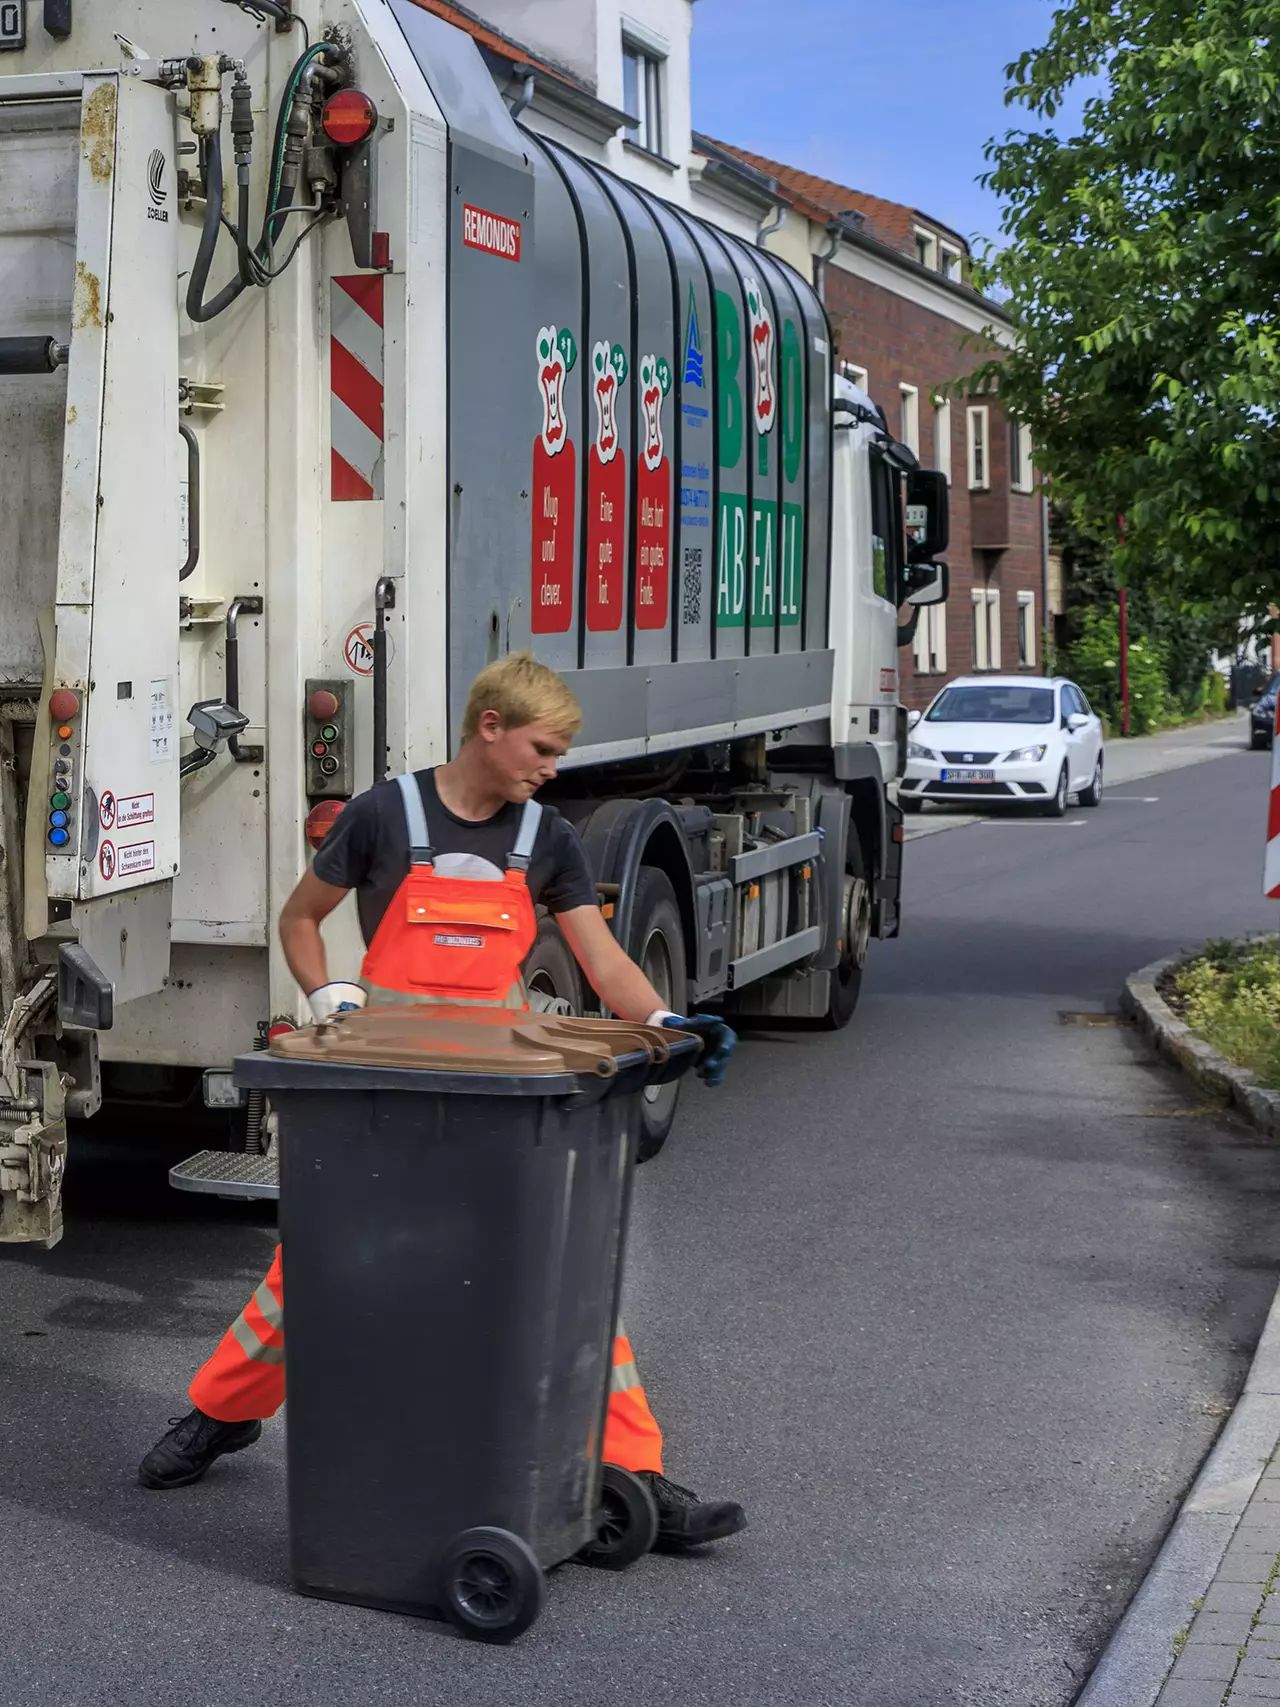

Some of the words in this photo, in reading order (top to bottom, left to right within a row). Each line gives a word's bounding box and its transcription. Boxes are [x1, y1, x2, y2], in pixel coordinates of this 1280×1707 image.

[147, 207, 169, 222] ZOELLER
[464, 207, 517, 256] REMONDIS
[714, 288, 802, 484] BO
[543, 485, 559, 526] Klug
[600, 491, 613, 522] Eine
[640, 497, 654, 527] Alles
[654, 498, 664, 528] hat
[541, 530, 556, 562] und
[599, 538, 613, 570] gute
[640, 539, 649, 566] ein
[649, 542, 664, 573] gutes
[717, 504, 797, 616] ABFALL
[540, 573, 563, 606] clever.
[598, 574, 610, 605] Tat.
[639, 575, 655, 606] Ende.
